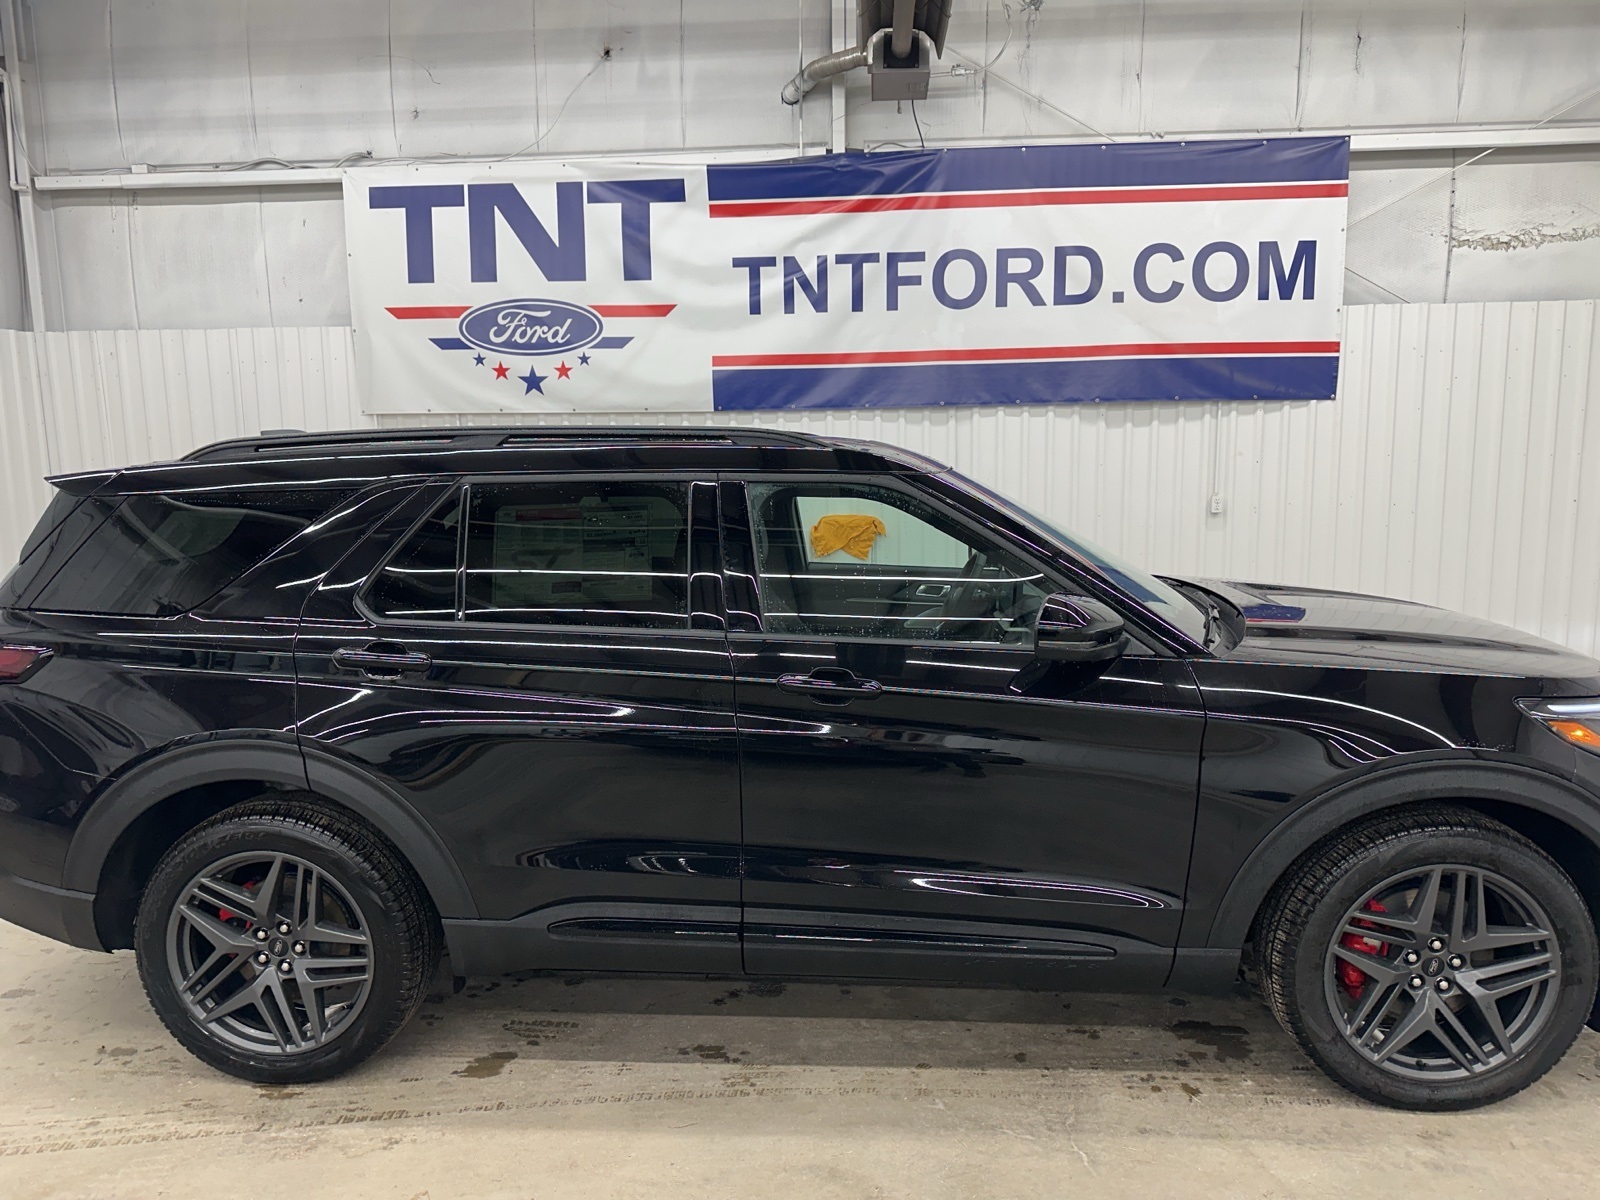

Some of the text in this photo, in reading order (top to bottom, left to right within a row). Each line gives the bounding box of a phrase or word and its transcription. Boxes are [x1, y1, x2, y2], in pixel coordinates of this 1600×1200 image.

[368, 178, 687, 284] TNT
[731, 239, 1318, 316] TNTFORD.COM
[488, 308, 572, 344] Ford
